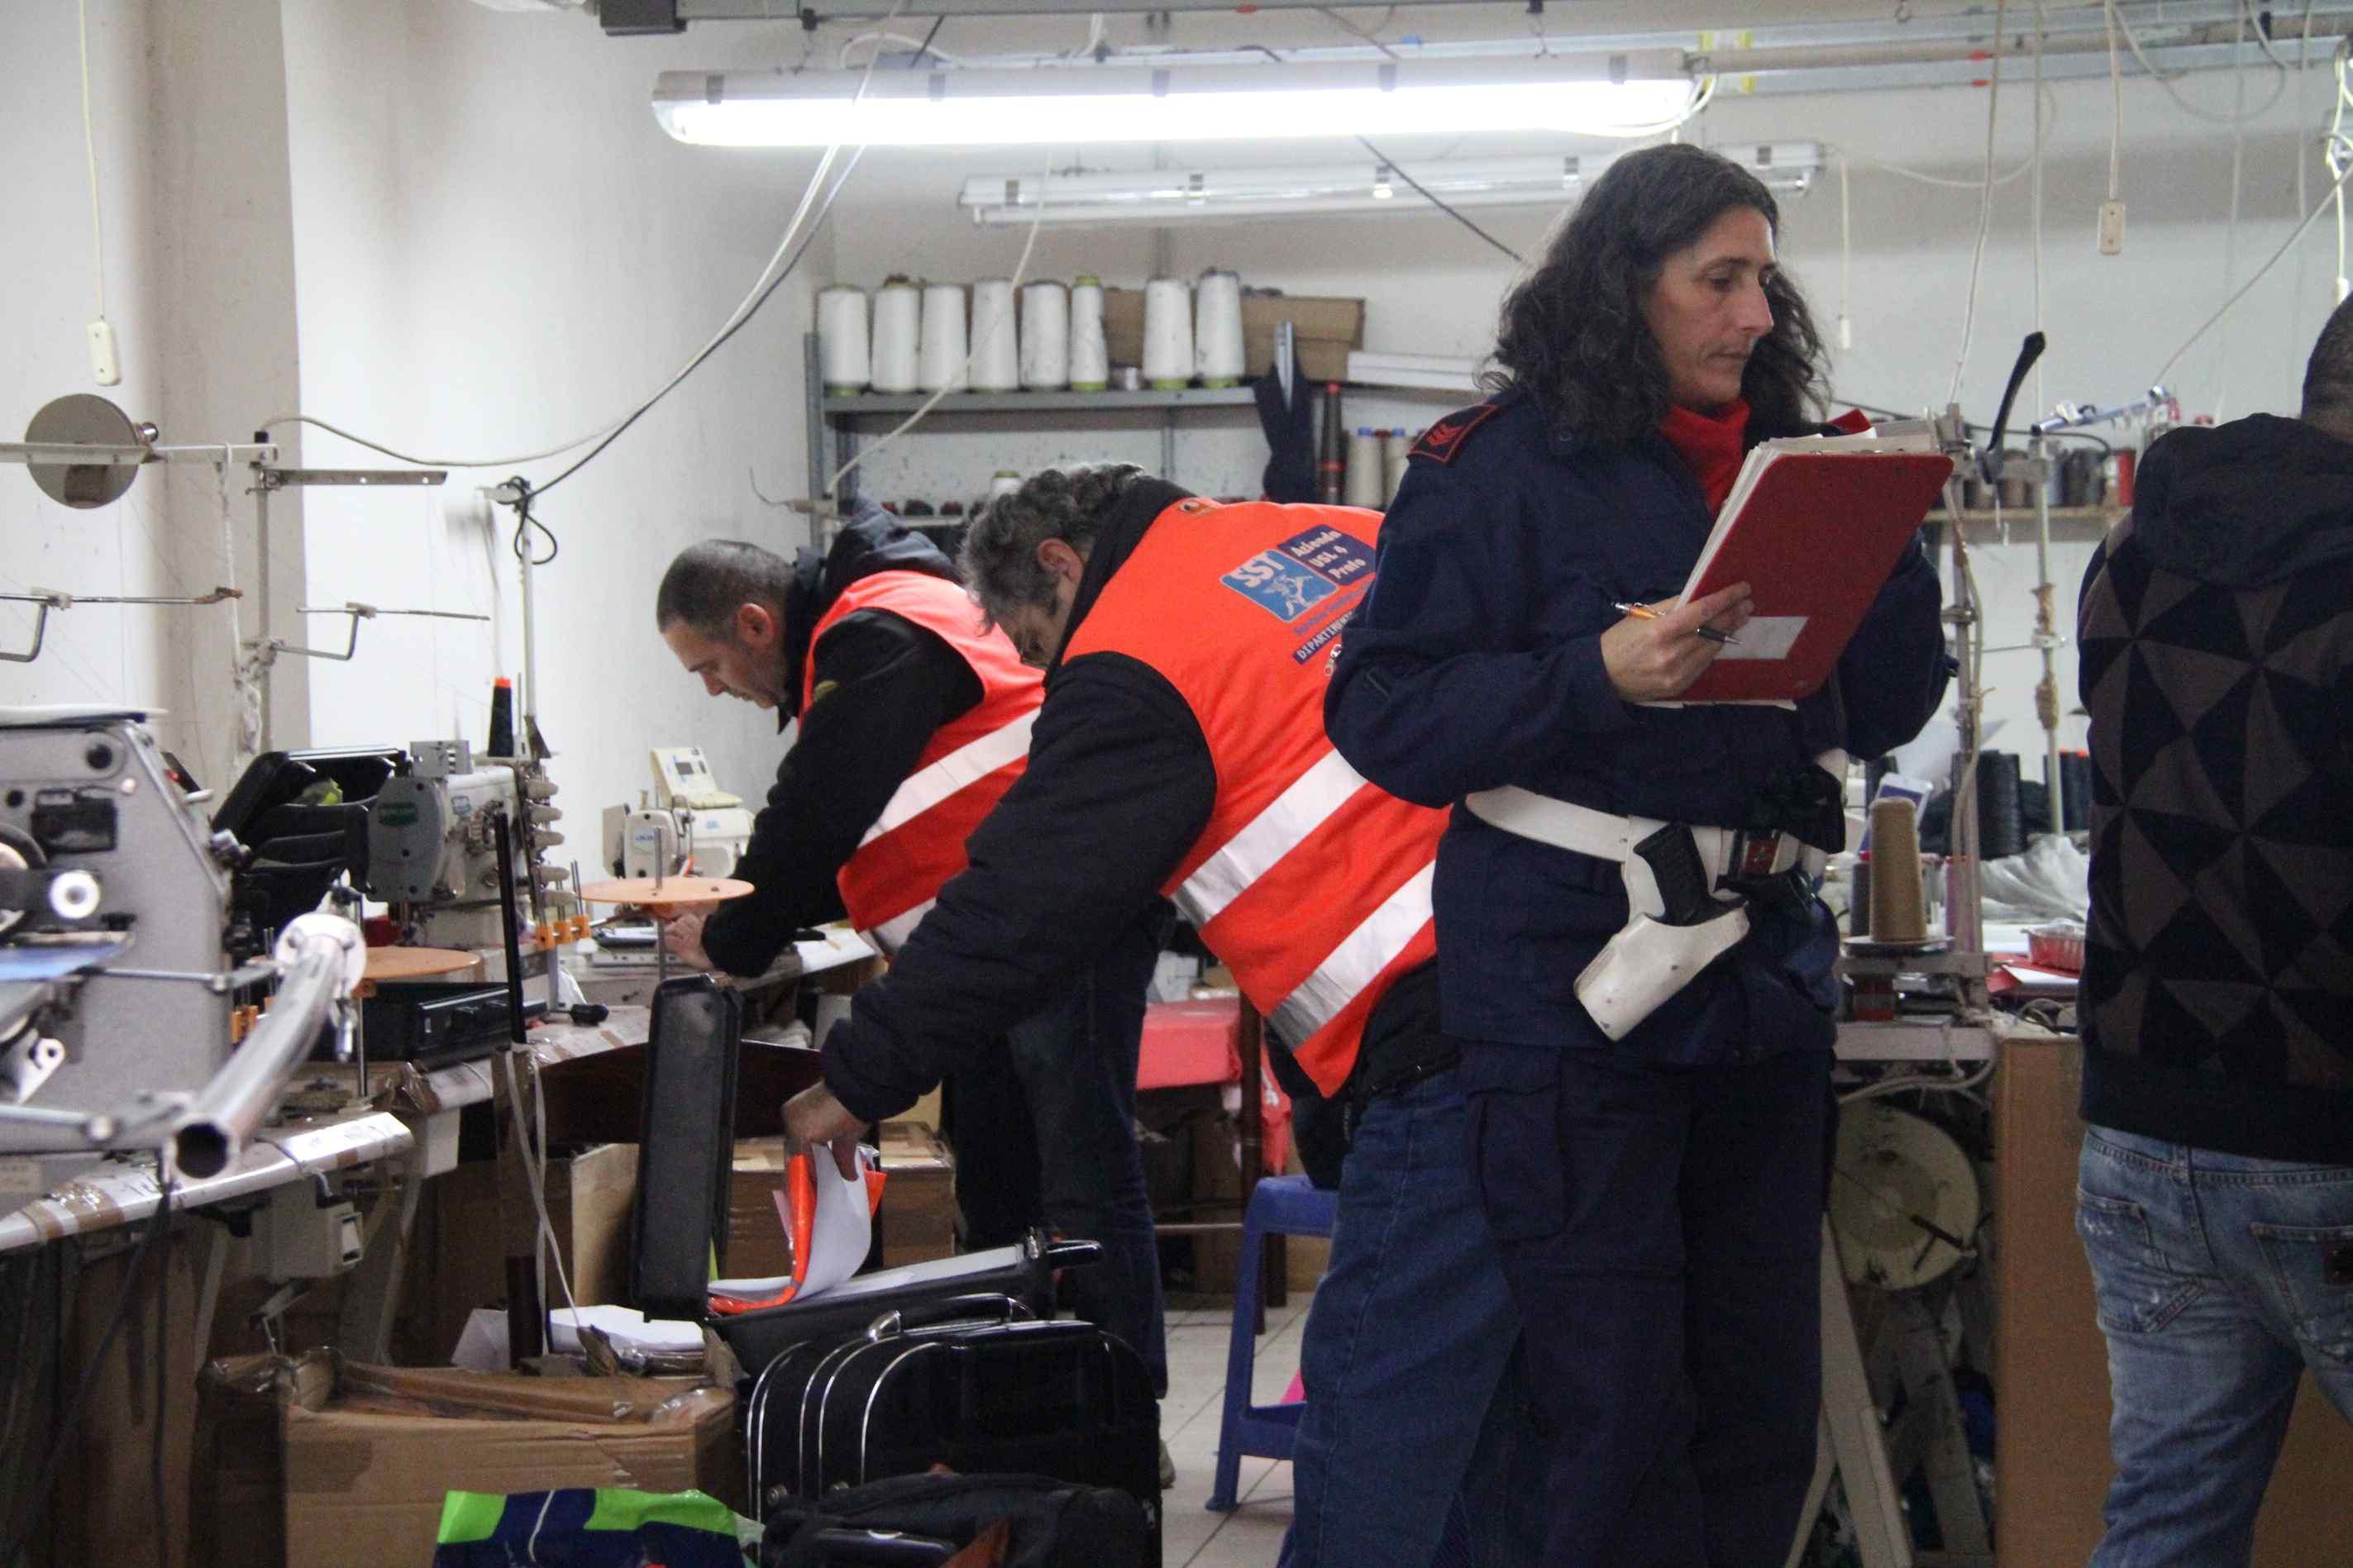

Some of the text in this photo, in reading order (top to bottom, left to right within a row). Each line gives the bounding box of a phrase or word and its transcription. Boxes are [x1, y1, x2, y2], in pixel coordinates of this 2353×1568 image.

[1291, 530, 1342, 557] Azienda
[1308, 545, 1349, 568] USL 4
[1328, 558, 1367, 579] Prato
[1296, 610, 1354, 660] DIPARTIMENT
